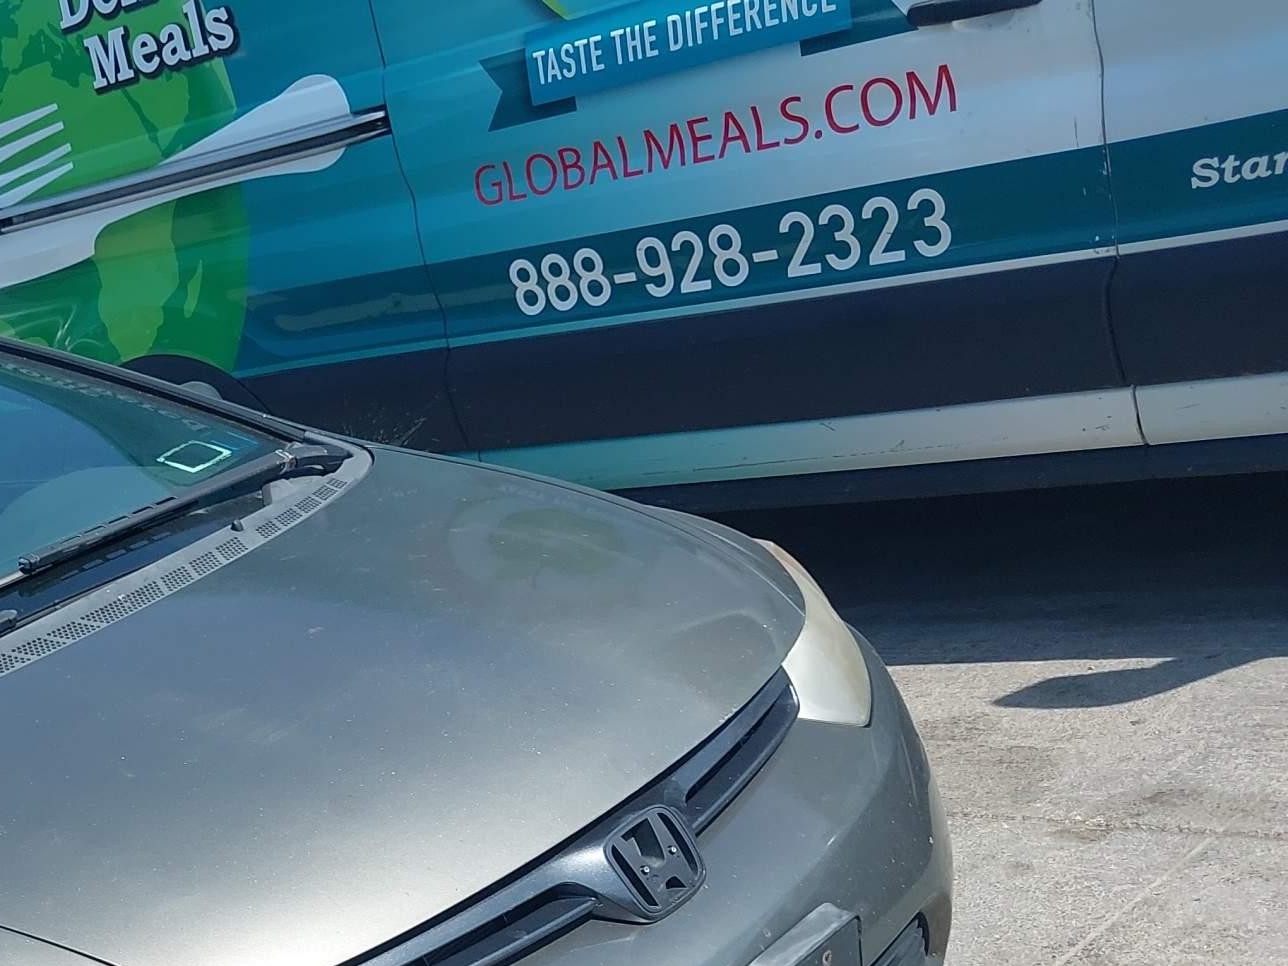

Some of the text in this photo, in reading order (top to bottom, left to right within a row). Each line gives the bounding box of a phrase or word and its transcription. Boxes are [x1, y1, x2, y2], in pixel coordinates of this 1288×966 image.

[83, 0, 234, 89] Meals
[532, 35, 605, 85] TASTE
[610, 20, 660, 65] THE
[473, 63, 958, 206] GLOBALMEALS.COM
[509, 187, 952, 317] 888-928-2323
